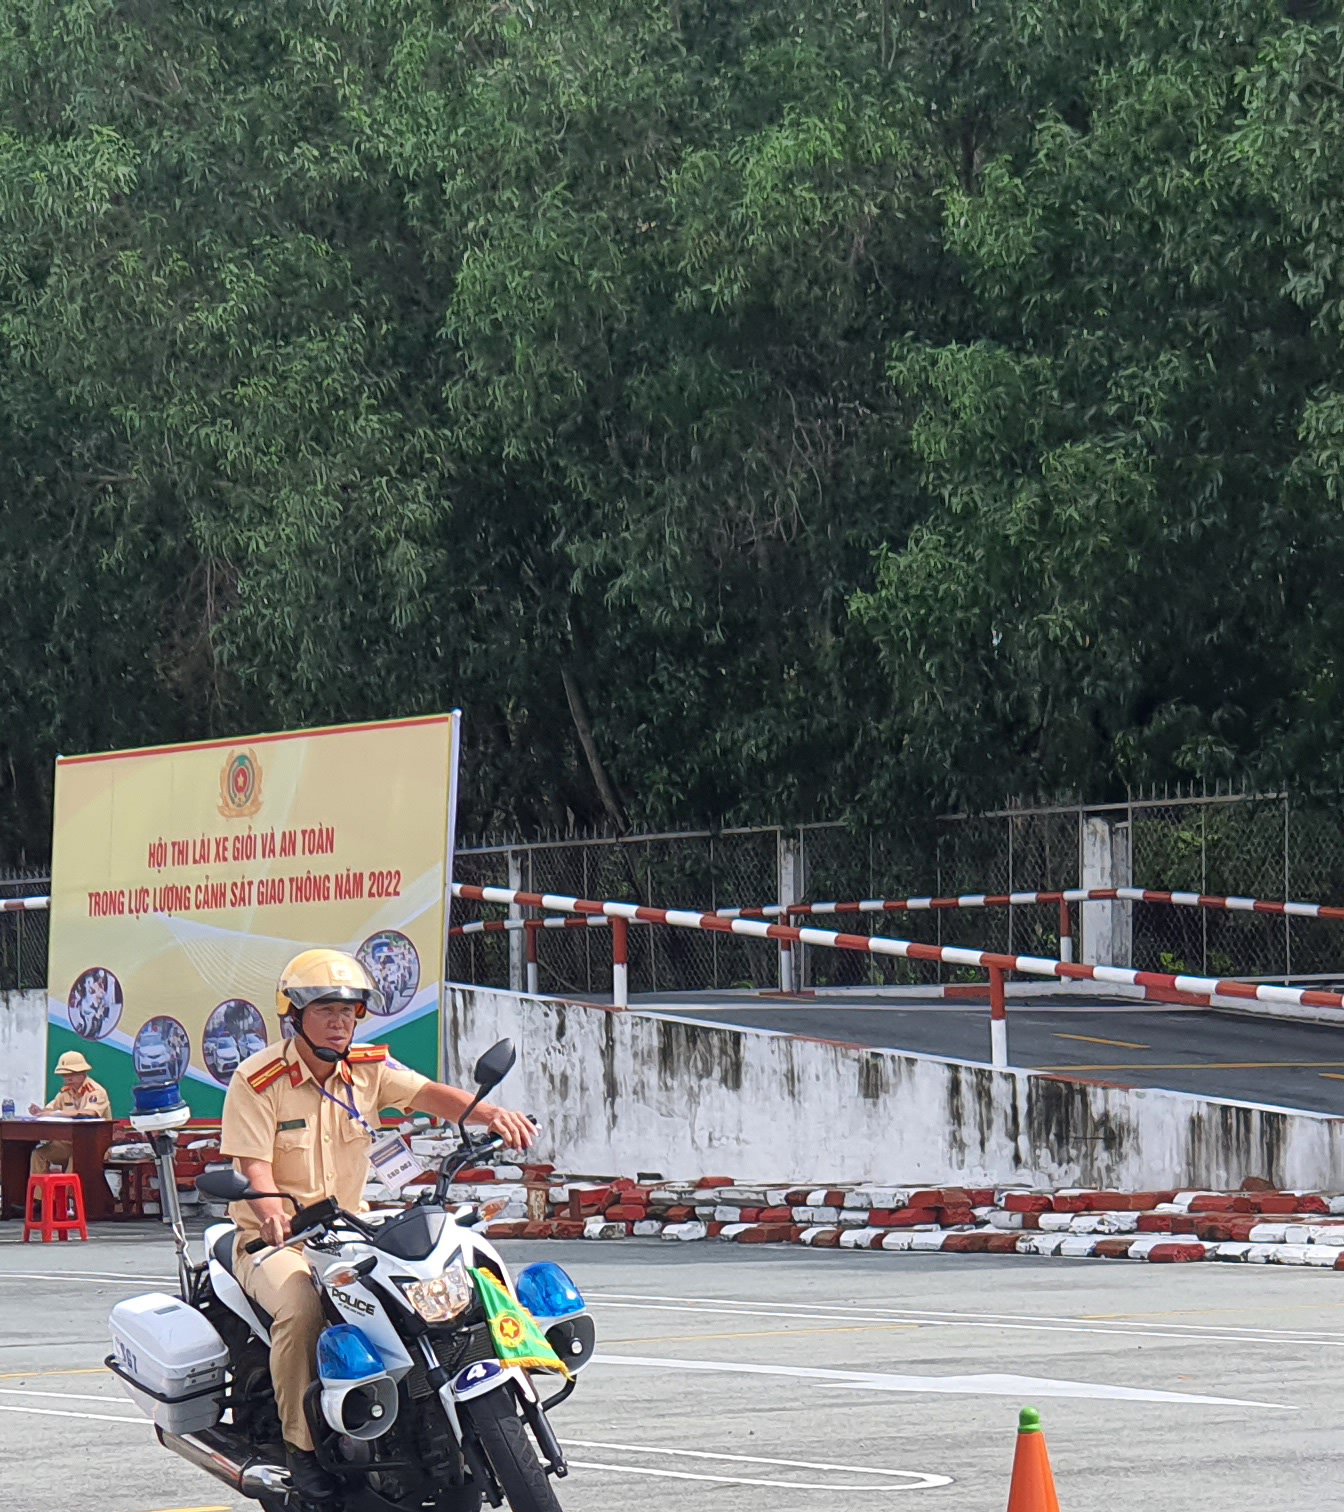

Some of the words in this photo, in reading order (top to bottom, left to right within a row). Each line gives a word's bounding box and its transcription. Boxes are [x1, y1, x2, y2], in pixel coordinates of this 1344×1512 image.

[148, 836, 167, 874] HỘI
[171, 839, 189, 867] THI
[192, 832, 210, 865] LÁI
[213, 836, 229, 864] XE
[232, 824, 257, 862] GIỎI
[260, 826, 276, 859] VÀ
[279, 830, 297, 857] AN
[300, 822, 335, 855] TOÀN
[88, 889, 125, 917] TRONG
[127, 886, 150, 920] LỰC
[153, 883, 191, 918] LƯỢNG
[194, 874, 227, 911] CẢNH
[229, 874, 254, 908] SÁT
[256, 877, 285, 906] GIAO
[288, 869, 331, 904] THÔNG
[334, 867, 364, 900] NĂM
[367, 869, 402, 899] 2022
[331, 1287, 376, 1316] POLICE
[466, 1363, 487, 1381] 4
